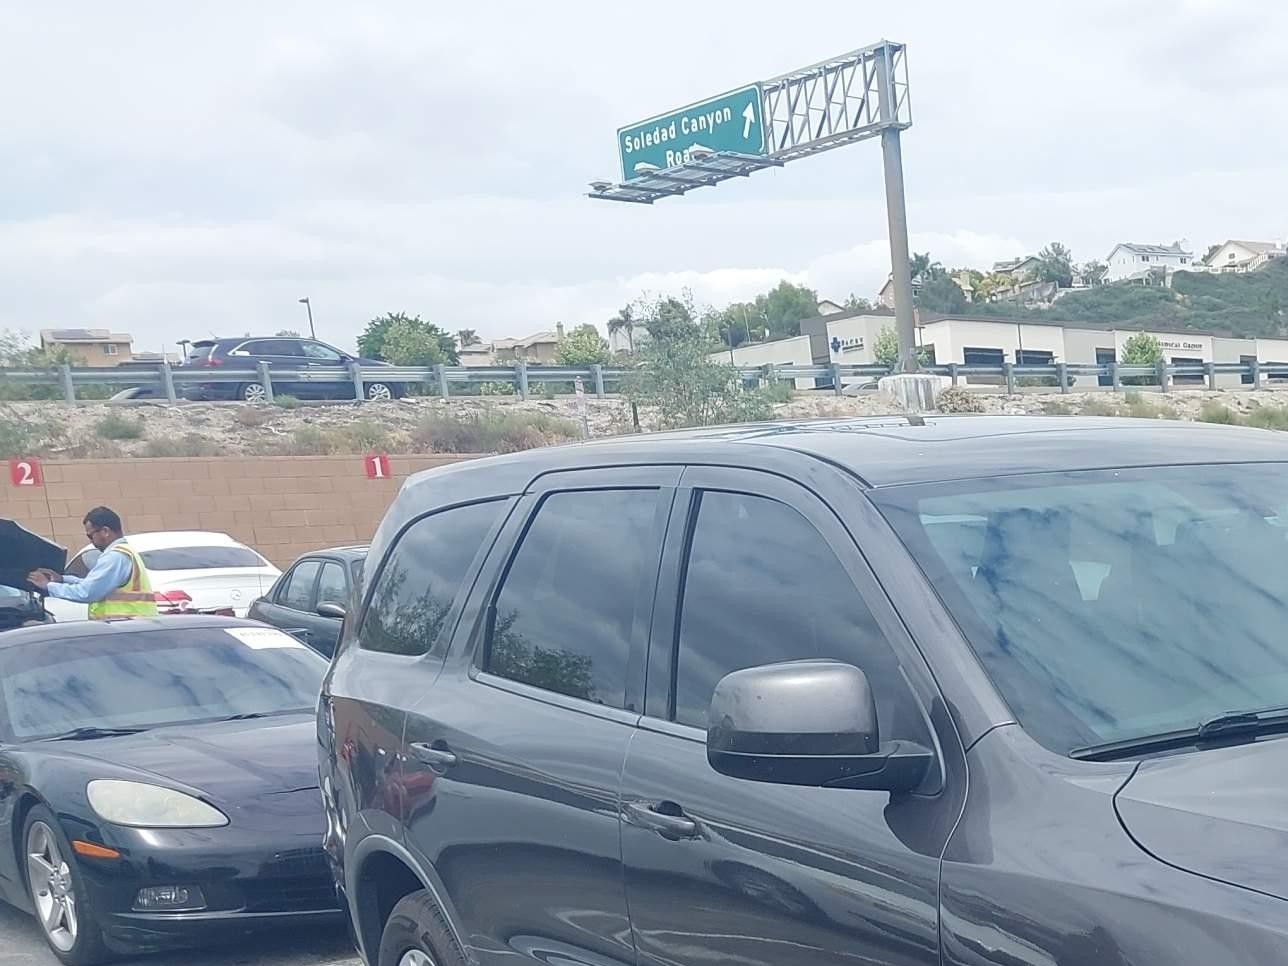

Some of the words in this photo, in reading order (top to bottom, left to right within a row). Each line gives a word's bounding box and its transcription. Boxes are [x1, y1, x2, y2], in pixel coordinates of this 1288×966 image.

[625, 120, 676, 153] Soledad
[681, 107, 732, 134] Canyon
[17, 462, 34, 485] 2
[372, 456, 384, 477] 1
